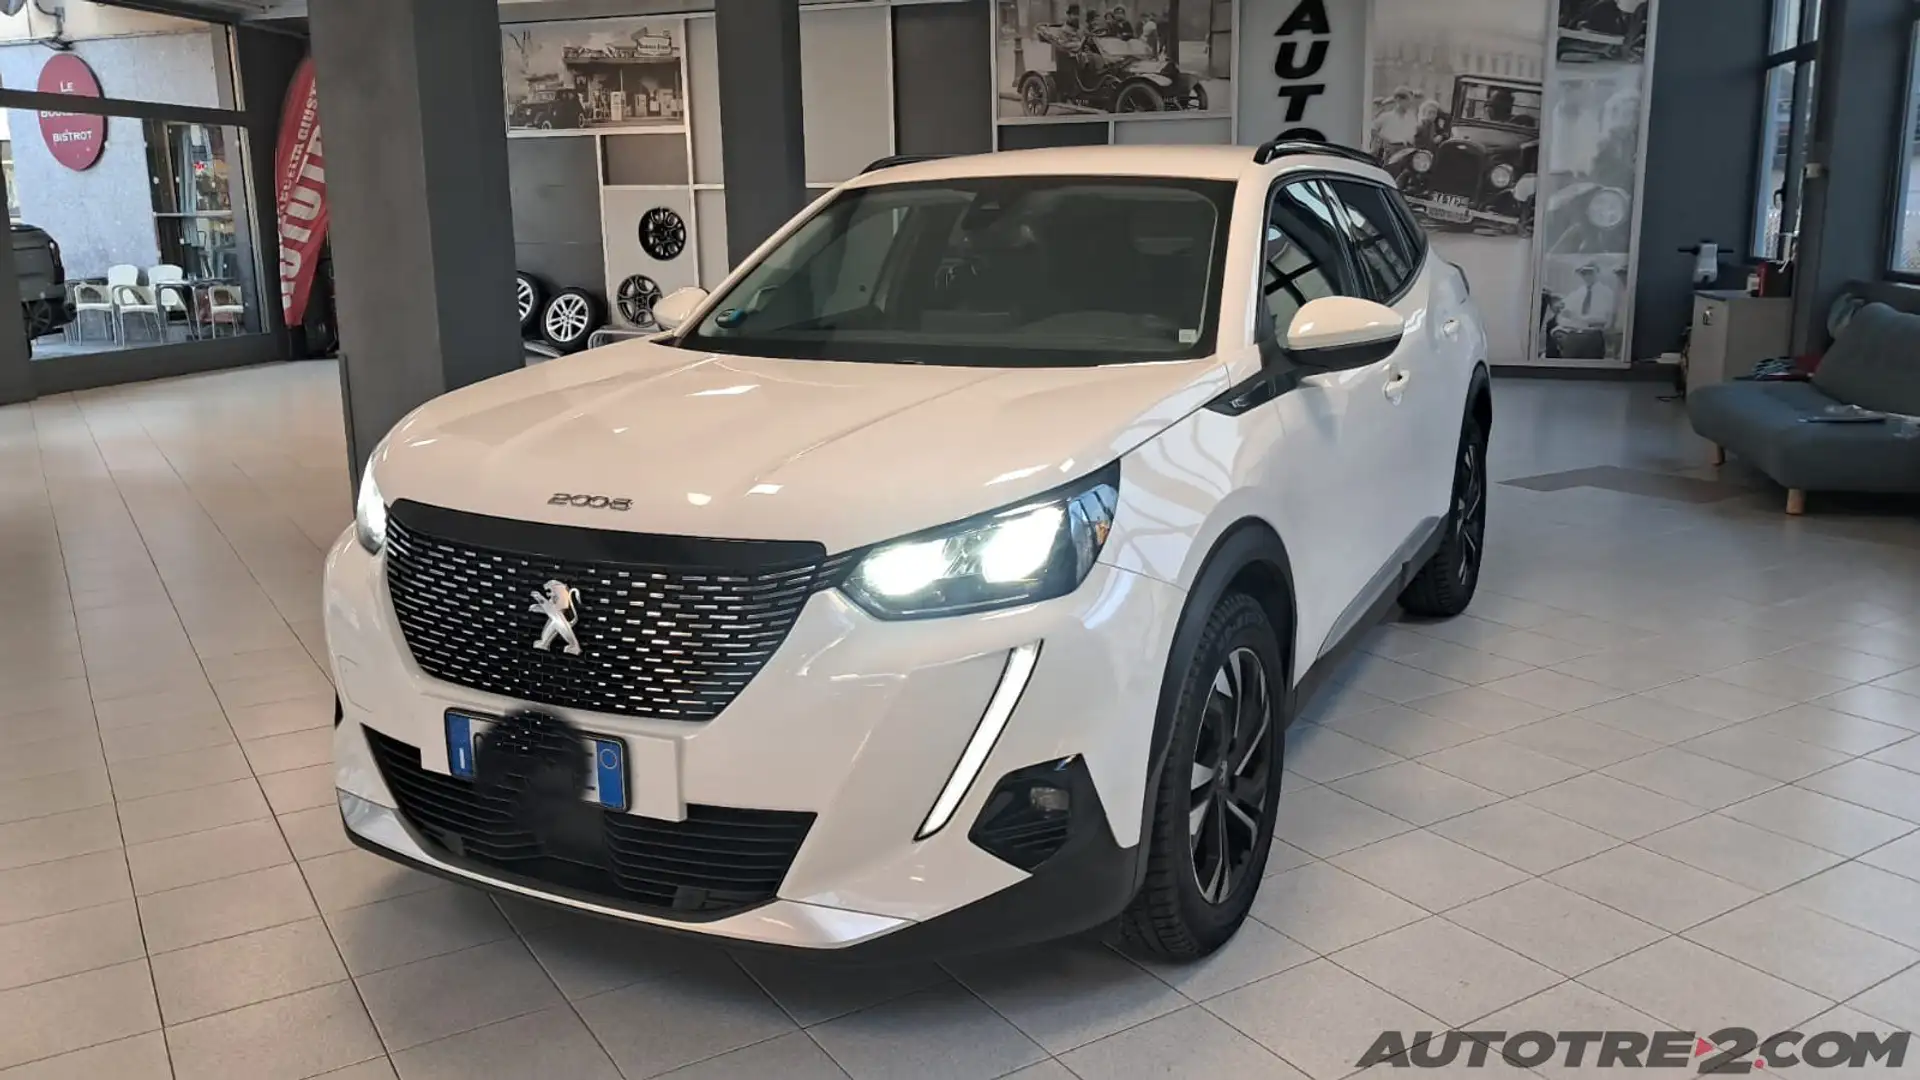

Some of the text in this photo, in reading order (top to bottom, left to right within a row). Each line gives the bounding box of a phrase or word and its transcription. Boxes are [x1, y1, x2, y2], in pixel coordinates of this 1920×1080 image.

[60, 81, 74, 92] LE
[52, 130, 93, 142] BISTROT
[547, 493, 634, 511] 2008
